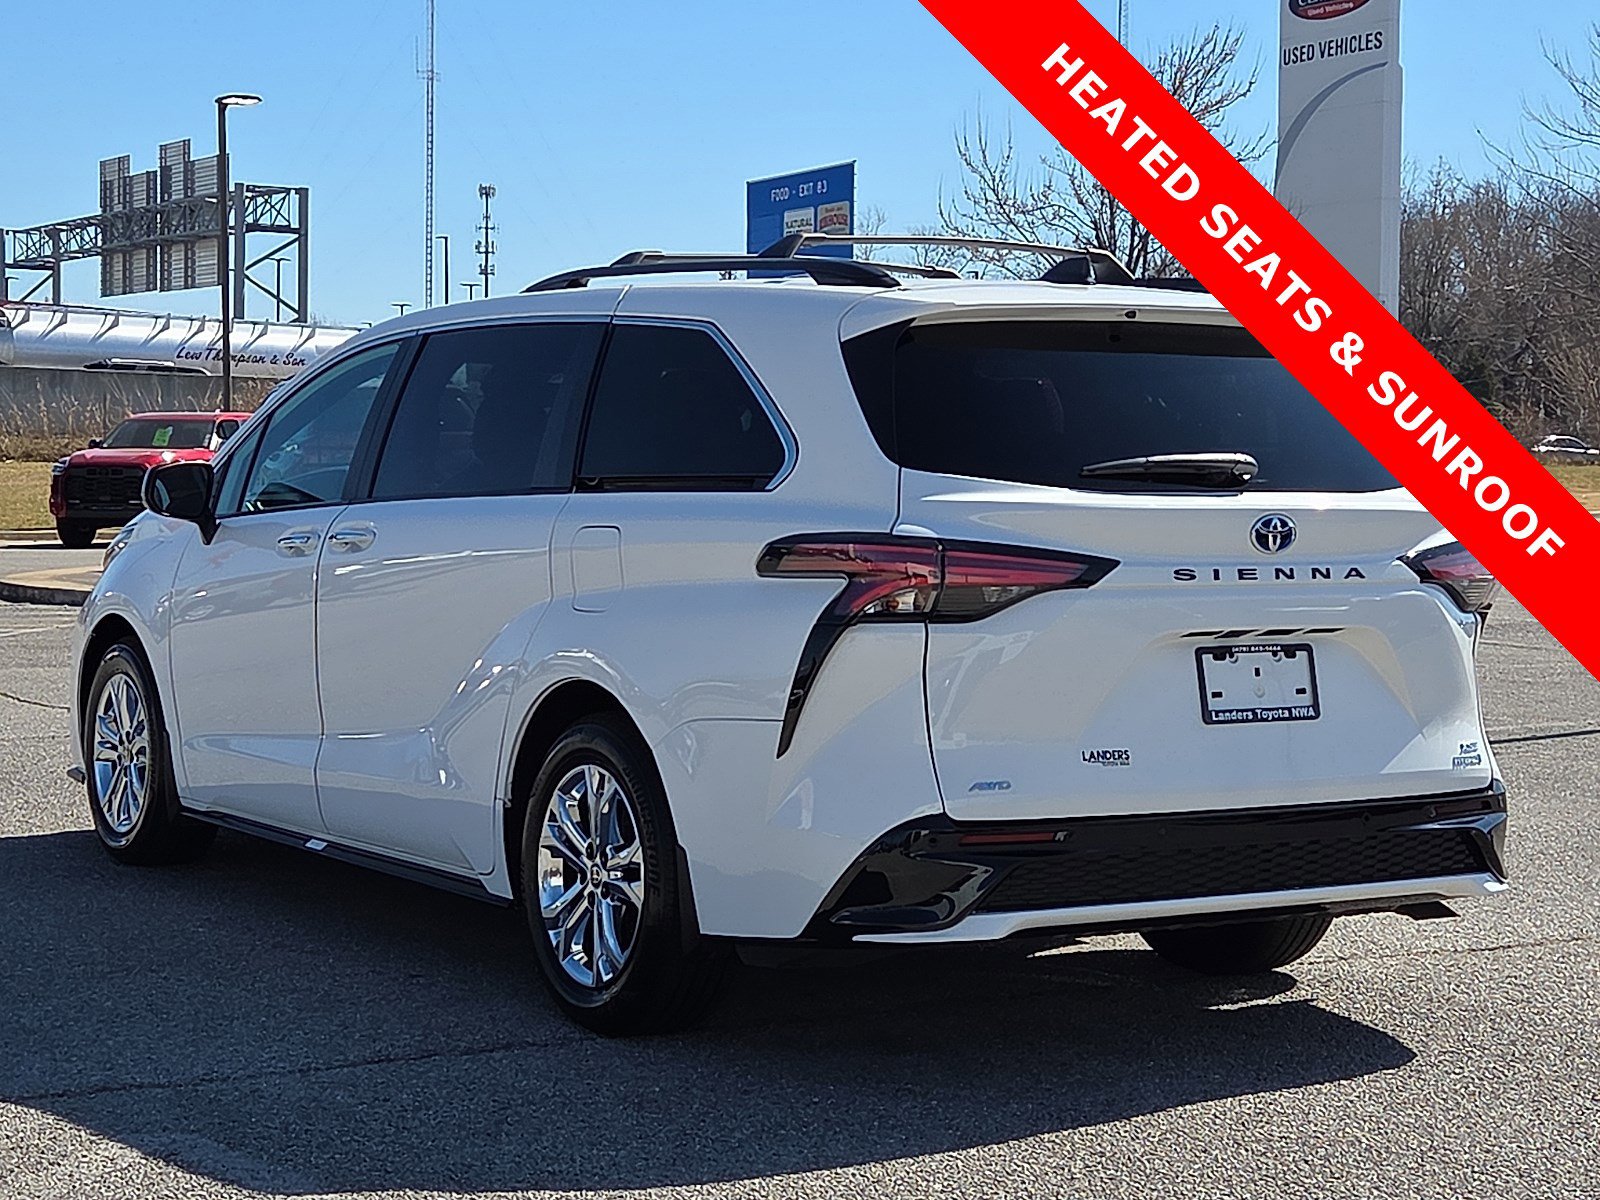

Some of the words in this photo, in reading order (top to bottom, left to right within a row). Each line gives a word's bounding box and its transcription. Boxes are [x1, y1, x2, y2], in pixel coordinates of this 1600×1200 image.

[1283, 44, 1315, 66] USED
[1318, 31, 1383, 59] VEHICLES
[770, 186, 790, 202] FOOD
[798, 181, 814, 198] EXIT
[176, 346, 203, 361] Lew
[282, 352, 306, 367] Son
[1172, 567, 1367, 582] SIENNA
[1211, 710, 1254, 721] Landers
[1255, 708, 1290, 720] Toyota
[1291, 706, 1316, 718] NWA
[1081, 749, 1130, 762] LANDERS
